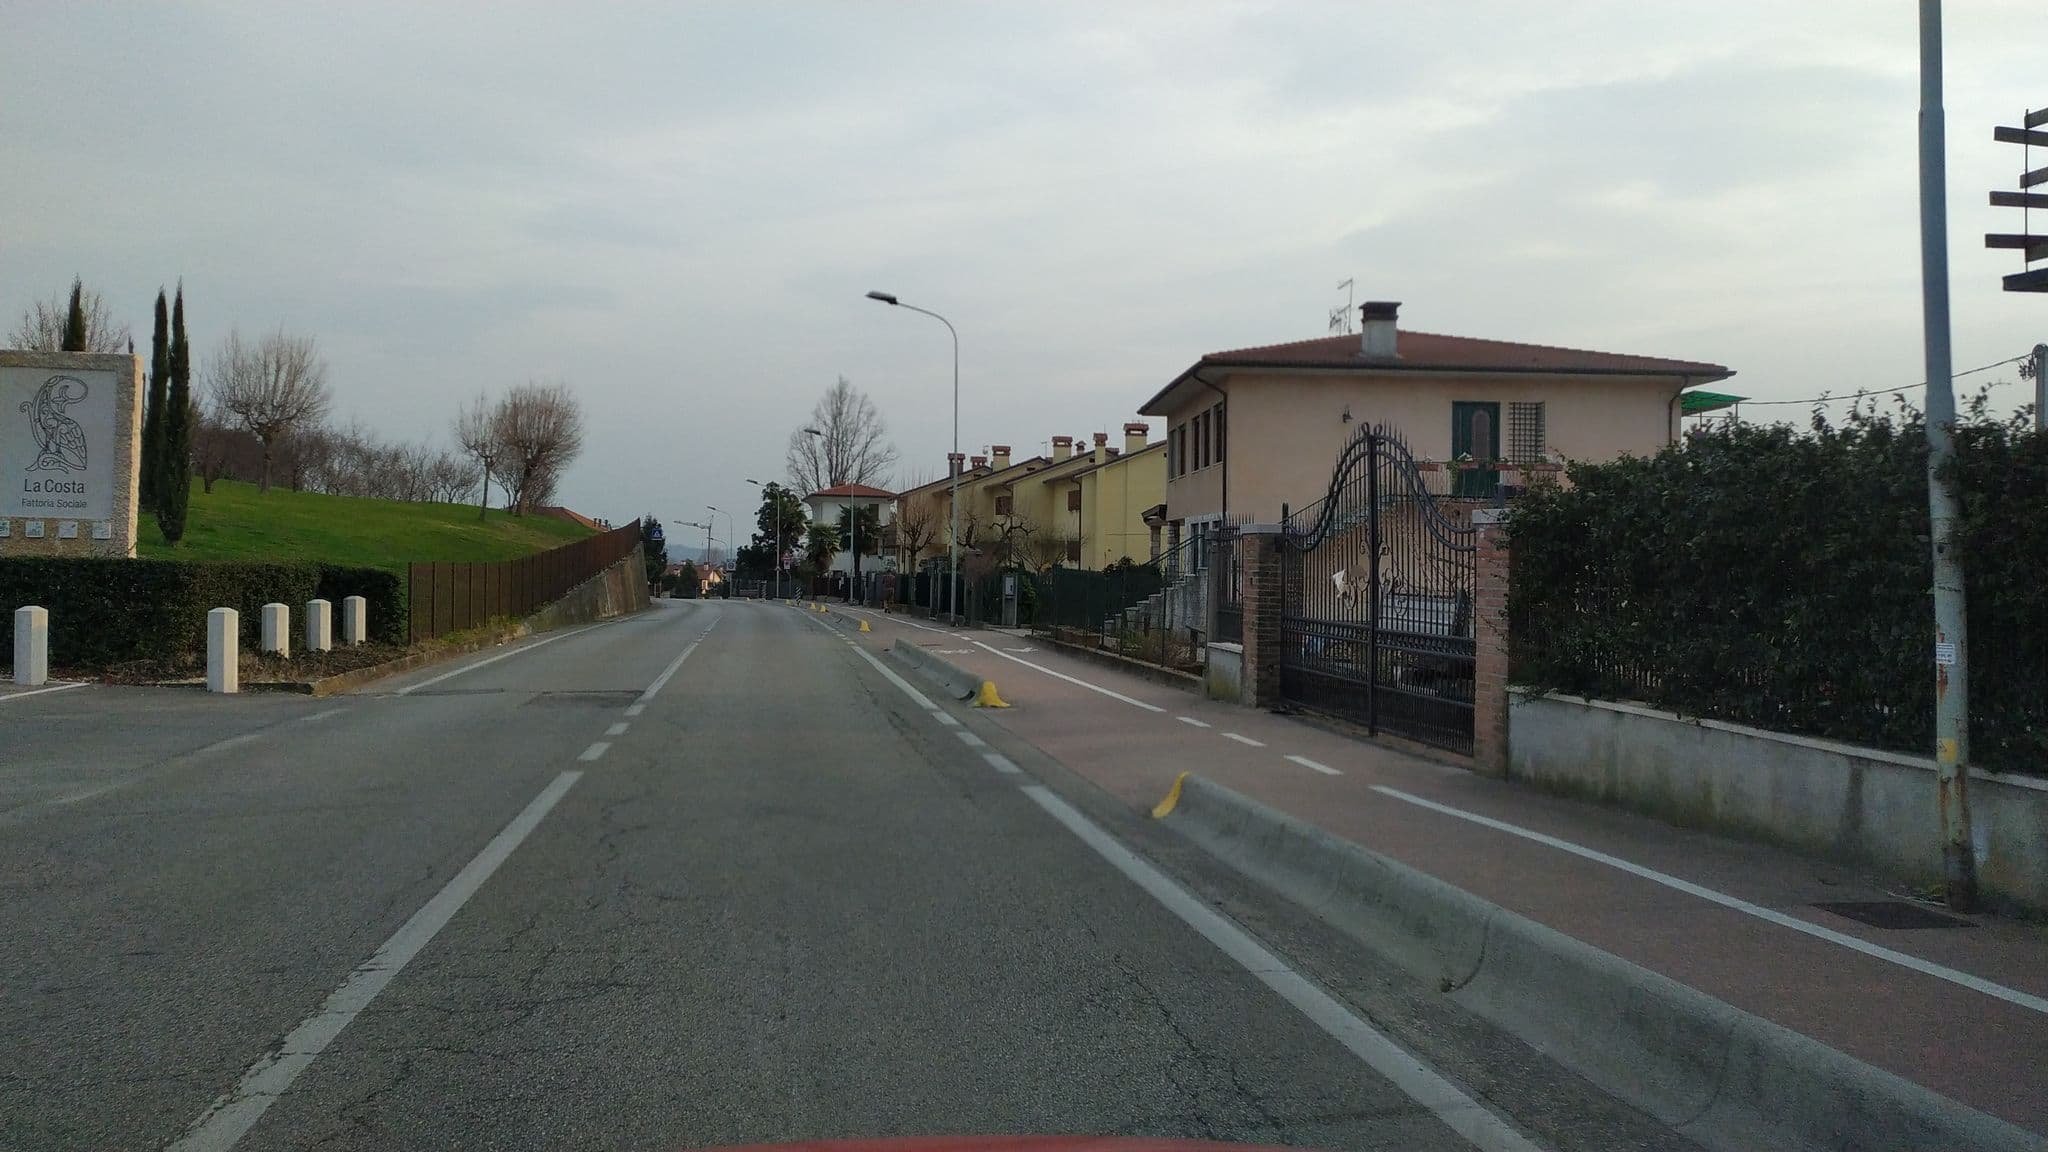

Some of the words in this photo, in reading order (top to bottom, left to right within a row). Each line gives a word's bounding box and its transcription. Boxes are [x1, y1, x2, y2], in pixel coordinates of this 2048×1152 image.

[24, 478, 41, 492] La
[44, 478, 85, 494] Costa
[21, 498, 55, 508] Fattoria
[56, 499, 87, 509] Sociale
